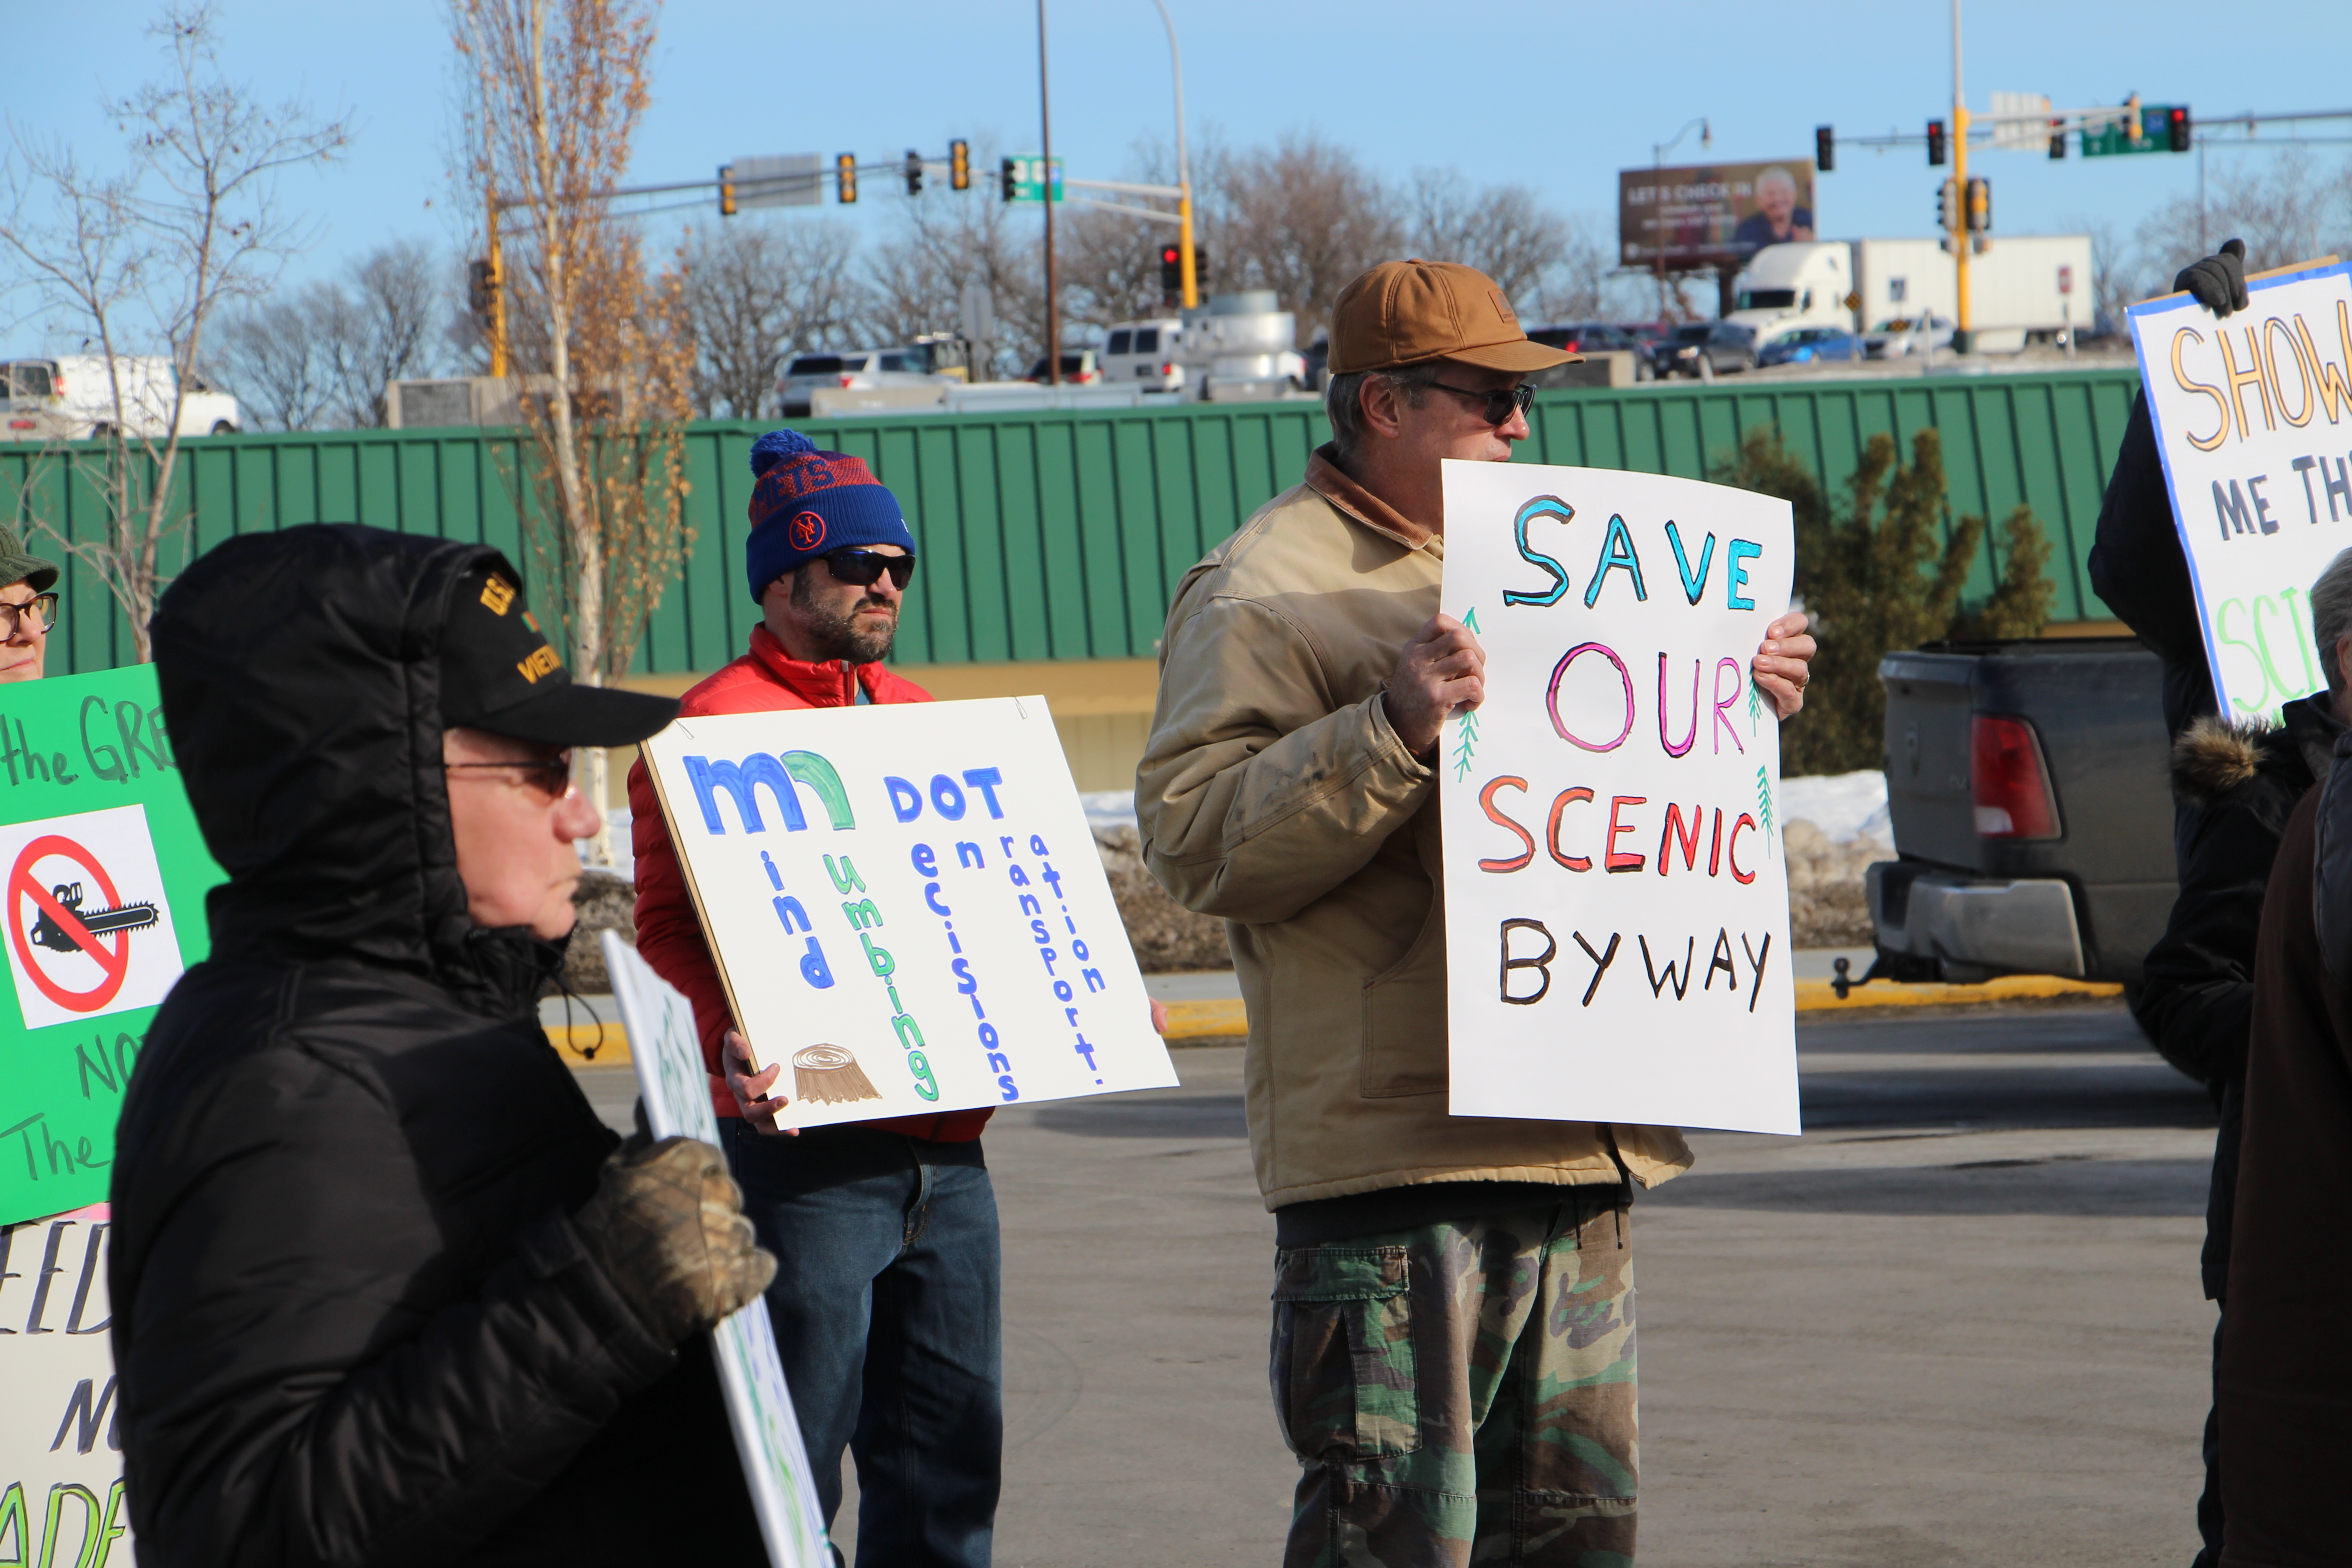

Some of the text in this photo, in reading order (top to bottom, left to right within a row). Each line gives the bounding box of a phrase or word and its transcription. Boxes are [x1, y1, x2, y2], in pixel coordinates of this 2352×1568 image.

[753, 459, 836, 521] METS
[794, 516, 816, 544] NY
[2211, 449, 2352, 541] ME TH
[1503, 495, 1763, 611] SAVE
[1546, 642, 1745, 758] OUR
[0, 713, 79, 787] the
[883, 766, 1003, 824] DOT
[1477, 774, 1756, 885] SCENIC
[1499, 917, 1771, 1013] BYWAY
[0, 1112, 111, 1181] The
[49, 1374, 122, 1455] N
